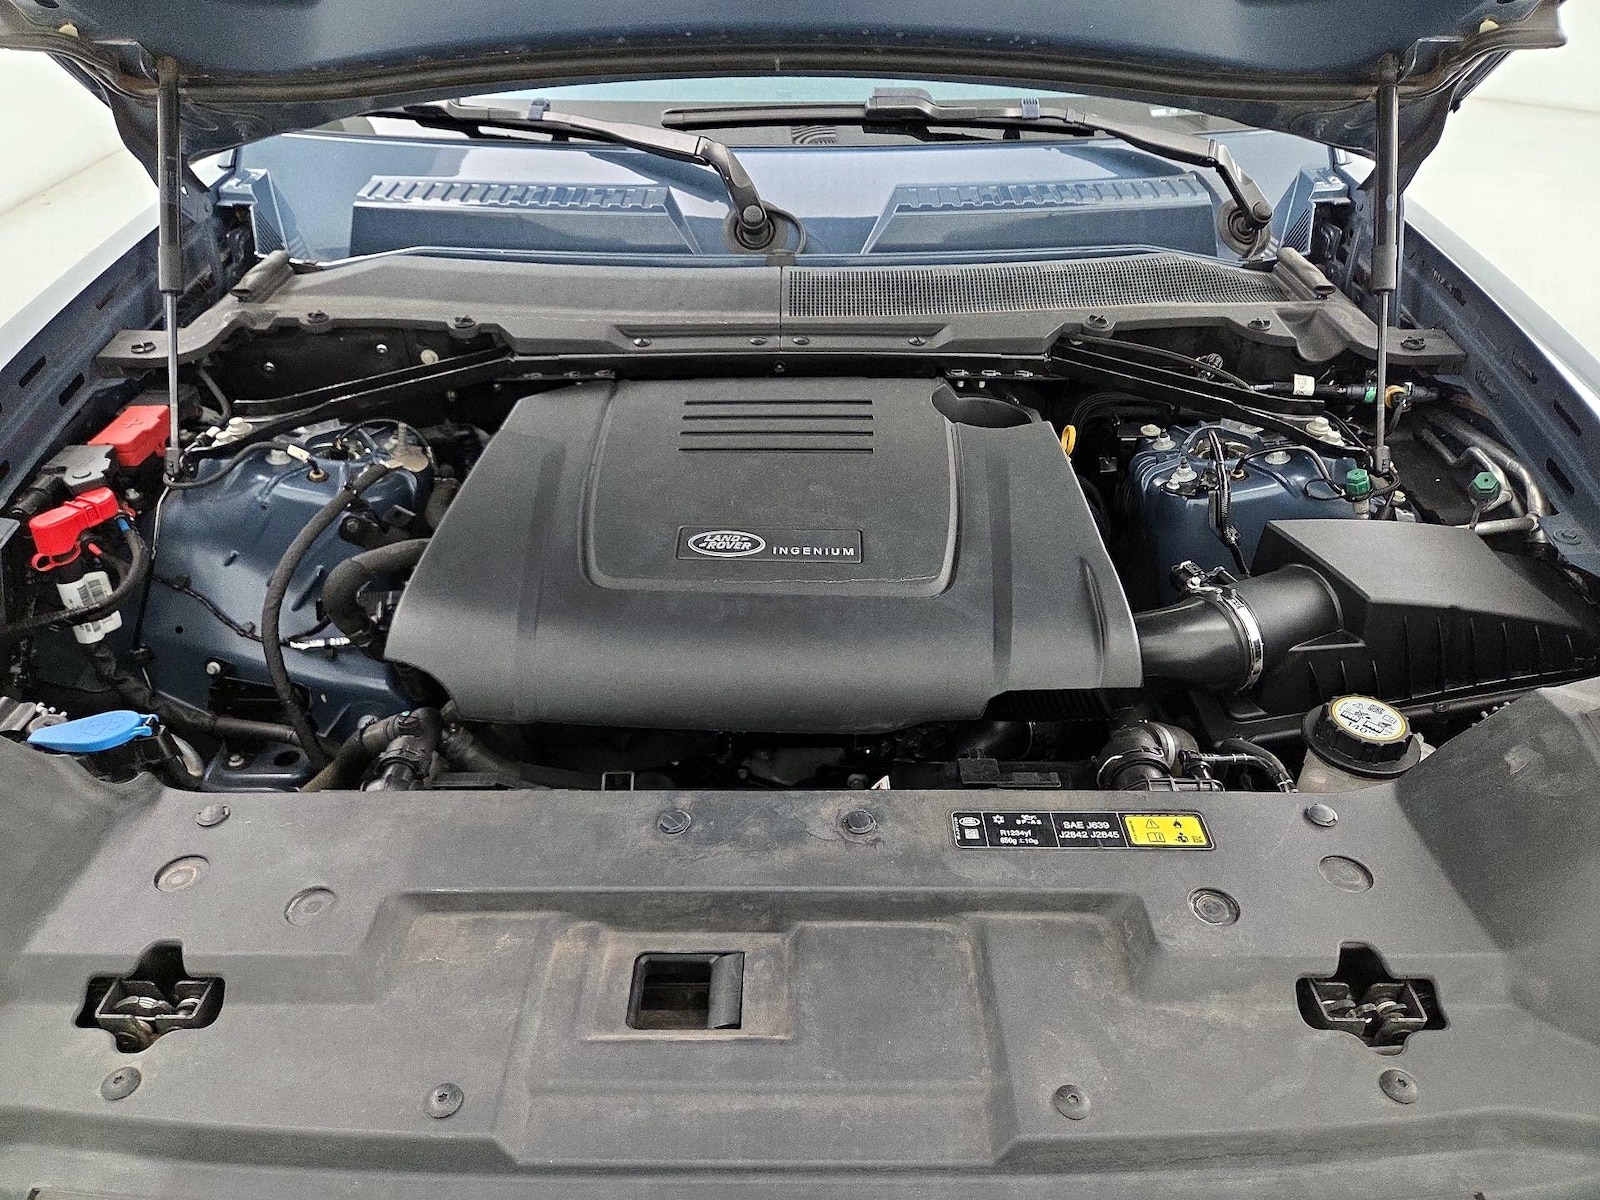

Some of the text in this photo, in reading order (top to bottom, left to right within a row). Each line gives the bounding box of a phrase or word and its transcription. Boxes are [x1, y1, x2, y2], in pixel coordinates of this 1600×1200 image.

[703, 534, 742, 542] LAND
[706, 541, 752, 550] ROVER
[772, 546, 855, 556] INGENIUM
[1063, 821, 1110, 829] SAE J639
[1058, 830, 1088, 839] J2842
[1090, 830, 1120, 839] J2845
